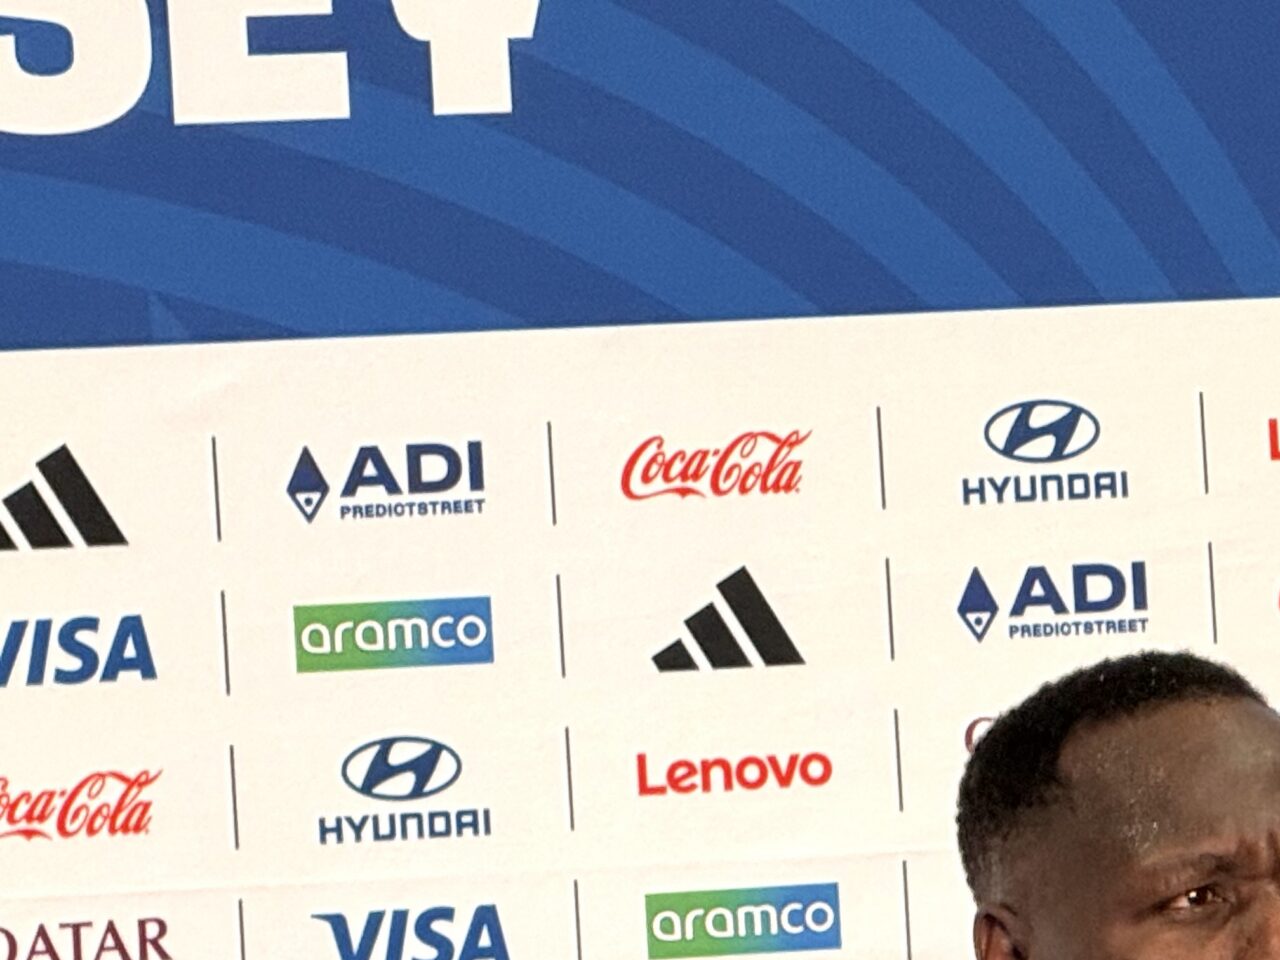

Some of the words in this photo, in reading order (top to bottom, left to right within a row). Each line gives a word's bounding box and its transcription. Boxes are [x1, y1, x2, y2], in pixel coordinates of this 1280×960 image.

[340, 441, 485, 498] ADI
[621, 430, 811, 500] Coca-Cola
[963, 471, 1128, 505] HYUNDAI
[340, 499, 485, 520] PREDICTSTREET
[1009, 561, 1149, 616] ADI
[301, 613, 488, 655] aramco
[1009, 618, 1149, 639] PREDICTSTREET
[637, 753, 832, 796] Lenovo
[319, 809, 491, 844] HYUNDAI
[651, 900, 836, 942] aramco
